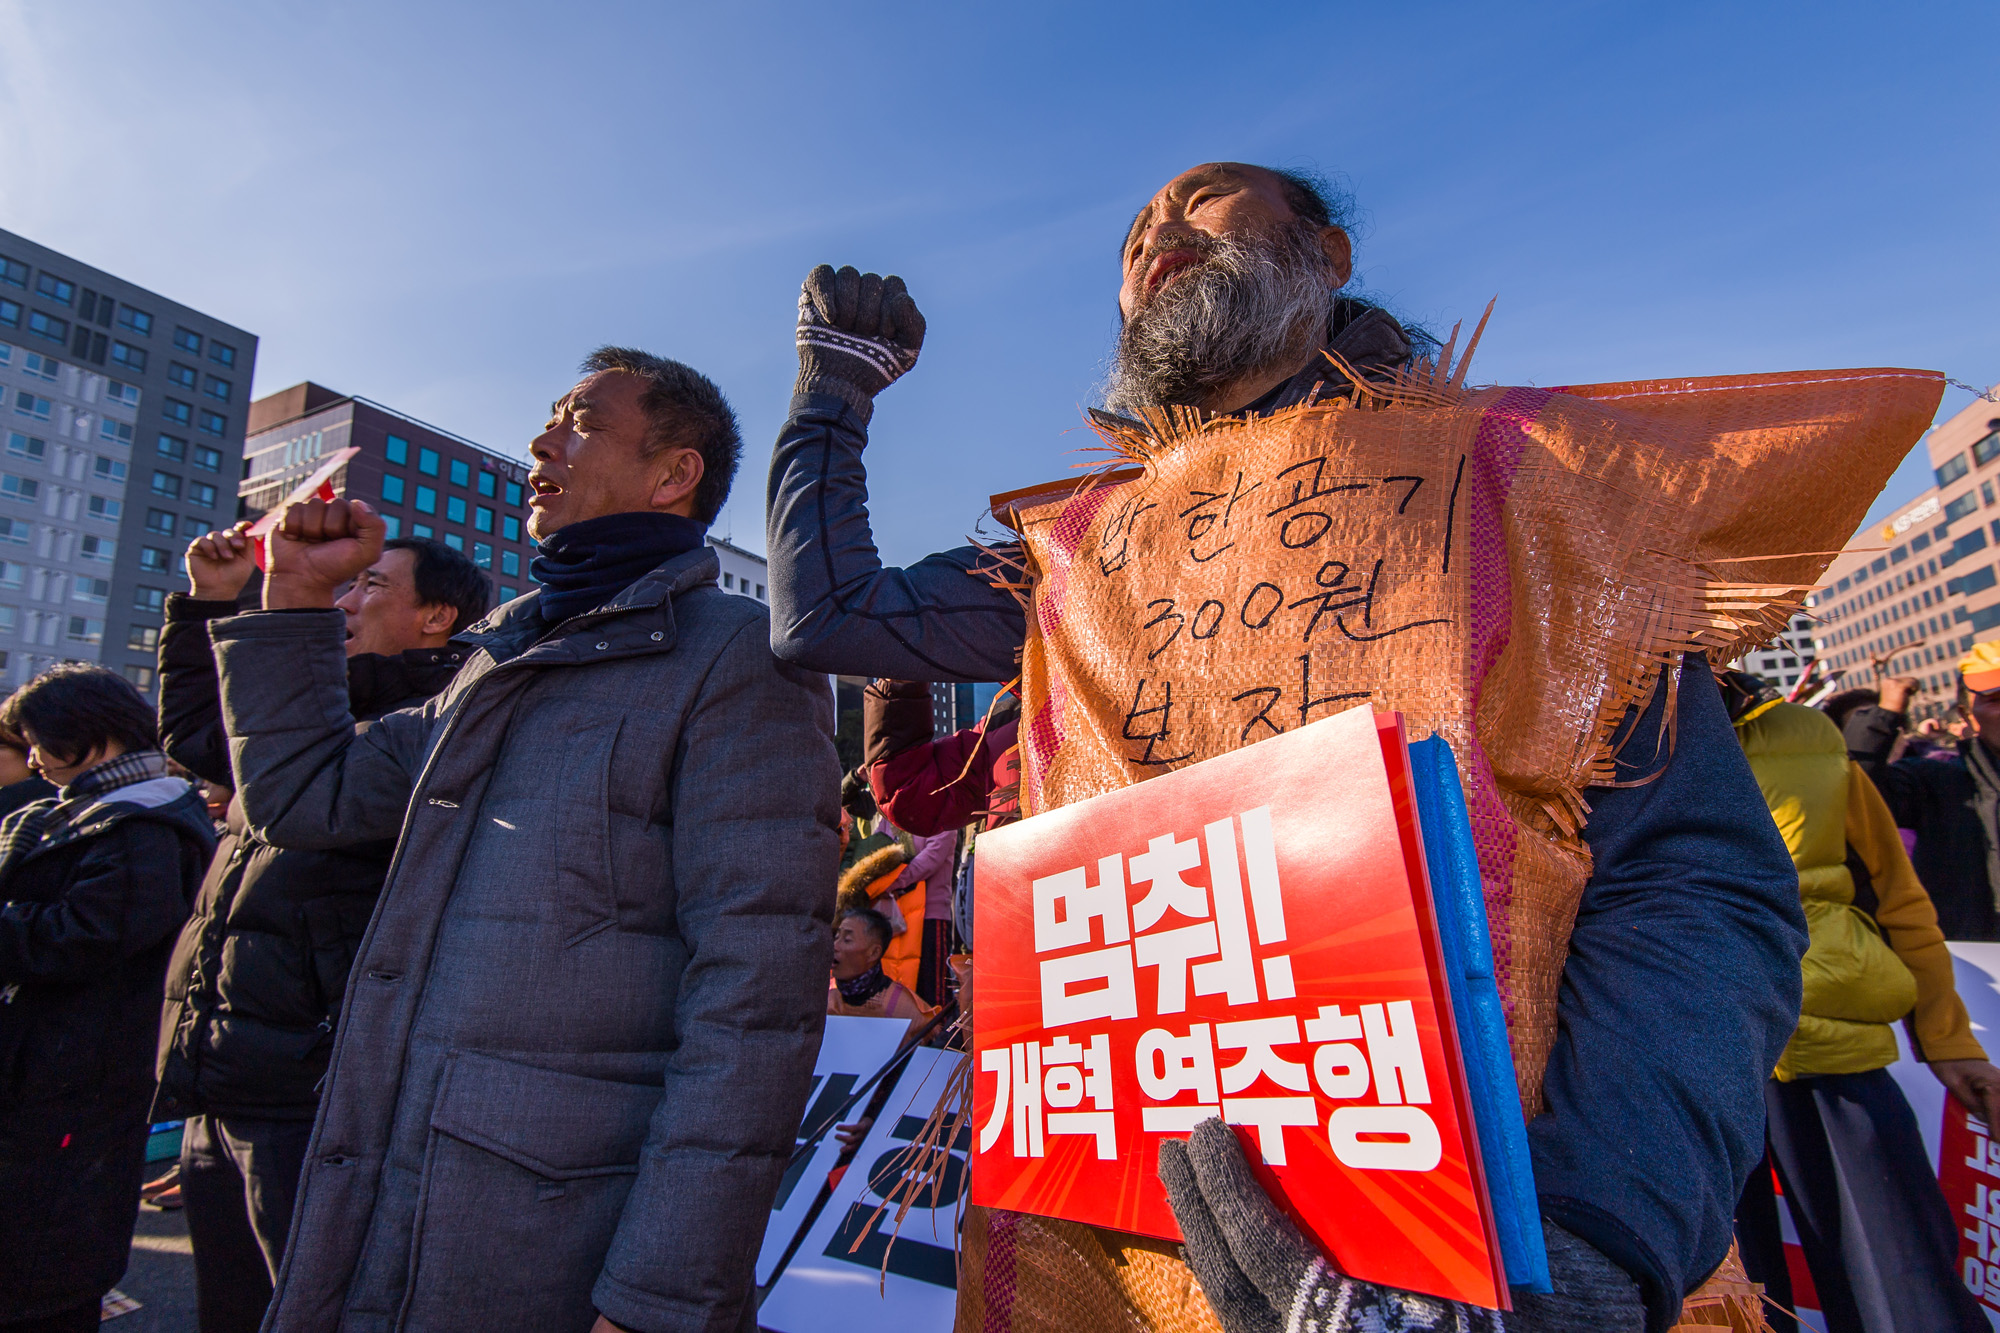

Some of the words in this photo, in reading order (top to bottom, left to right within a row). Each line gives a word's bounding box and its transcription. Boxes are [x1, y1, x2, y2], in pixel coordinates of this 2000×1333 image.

[1143, 558, 1454, 660] 300원
[1032, 805, 1296, 1029] 멈춰!
[979, 1034, 1117, 1160] 개혁
[1135, 1000, 1443, 1172] 역주행
